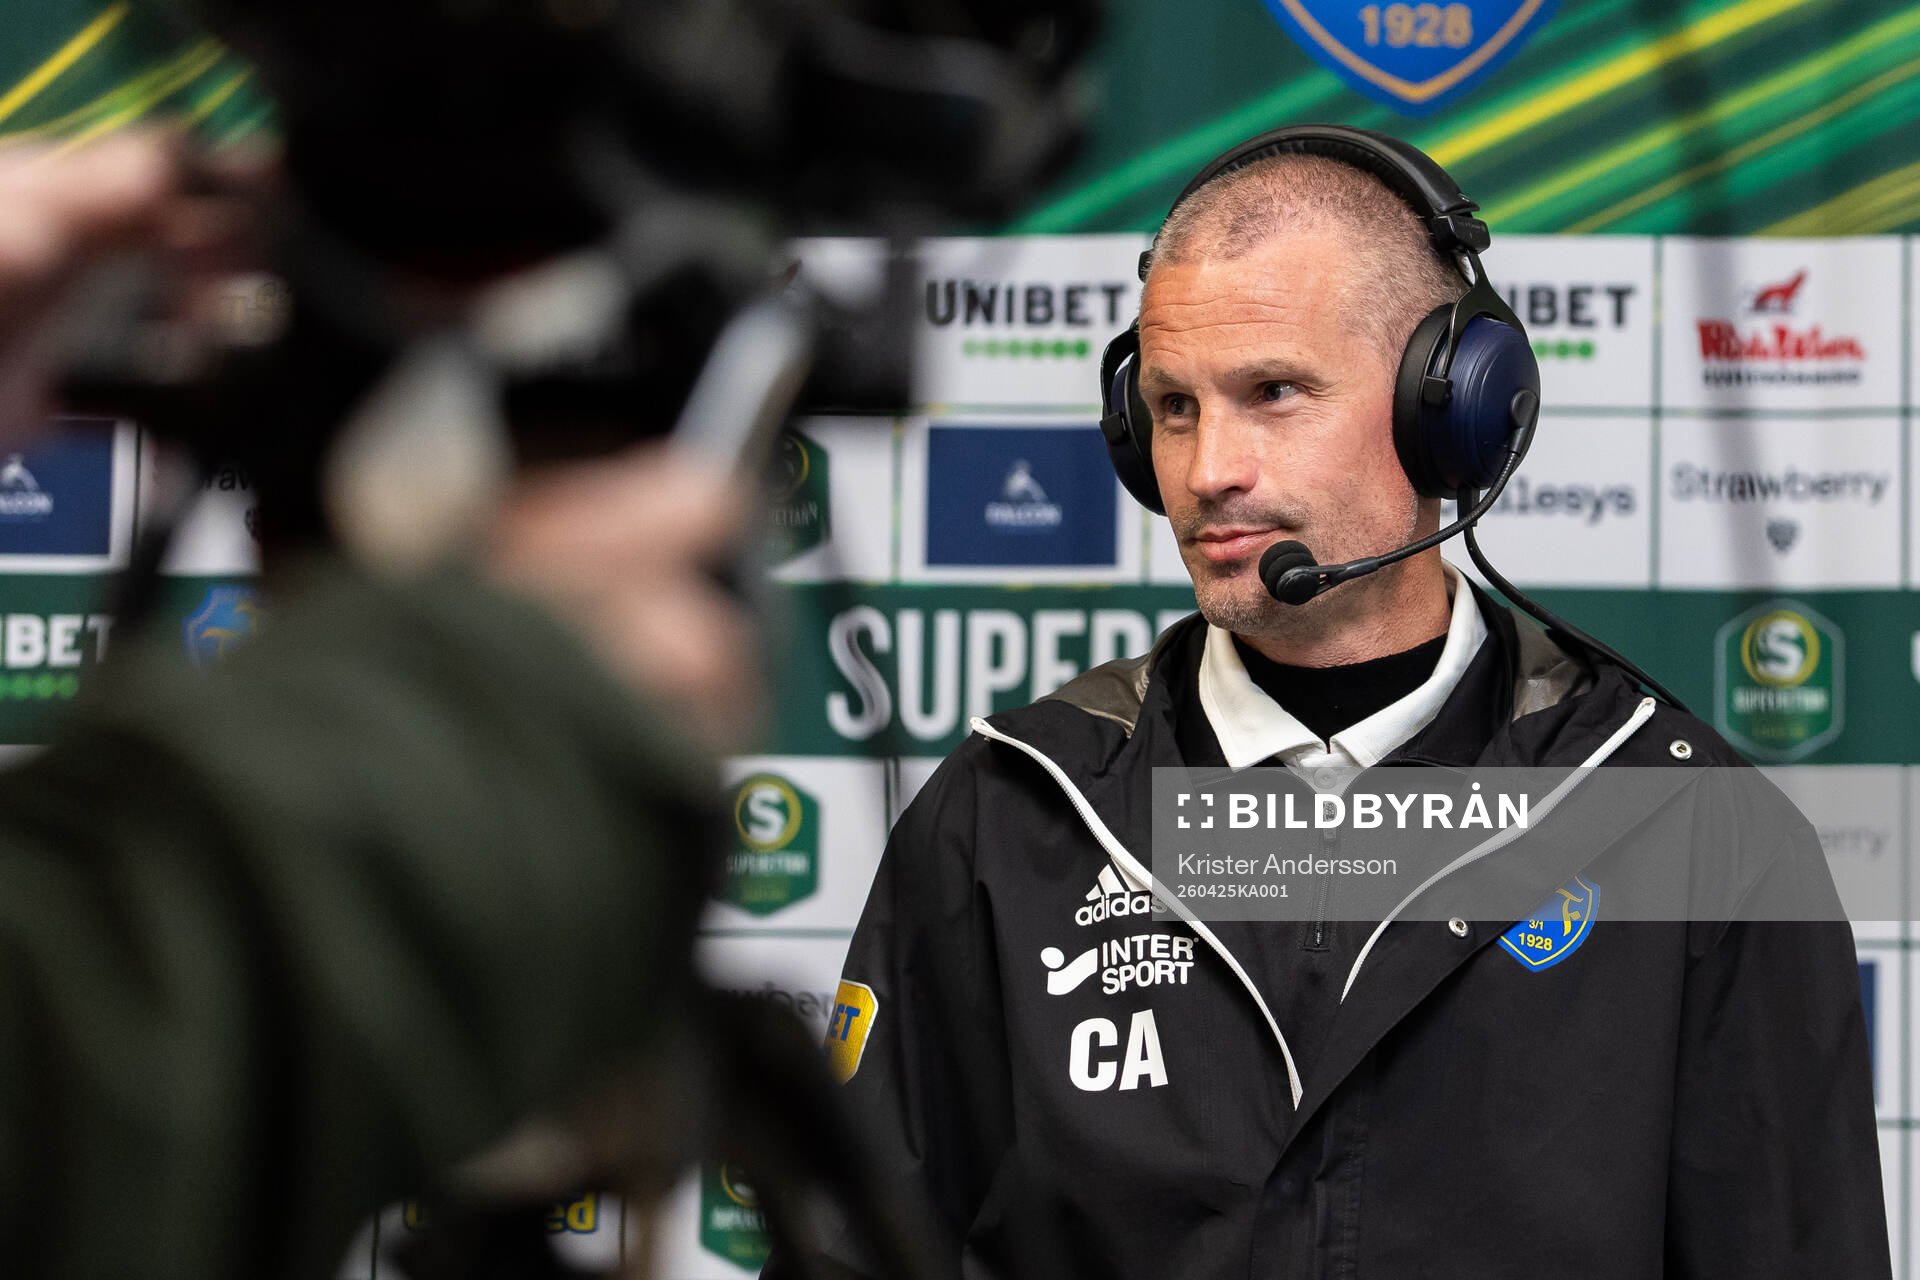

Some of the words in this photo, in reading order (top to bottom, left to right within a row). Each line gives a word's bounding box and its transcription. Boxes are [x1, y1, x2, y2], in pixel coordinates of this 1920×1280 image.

[1359, 3, 1472, 48] 1928
[926, 279, 1129, 326] UNIBET
[1490, 284, 1635, 327] IBET
[1670, 463, 1890, 507] Strawberry
[0, 613, 114, 669] BET
[826, 604, 1190, 741] SUPE
[1075, 891, 1168, 926] adidas
[1528, 919, 1544, 931] 3/1
[1102, 934, 1194, 968] INTER
[1518, 932, 1553, 951] 1928
[1101, 959, 1195, 996] SPORT
[829, 1003, 861, 1041] ET
[1069, 1008, 1169, 1092] CA
